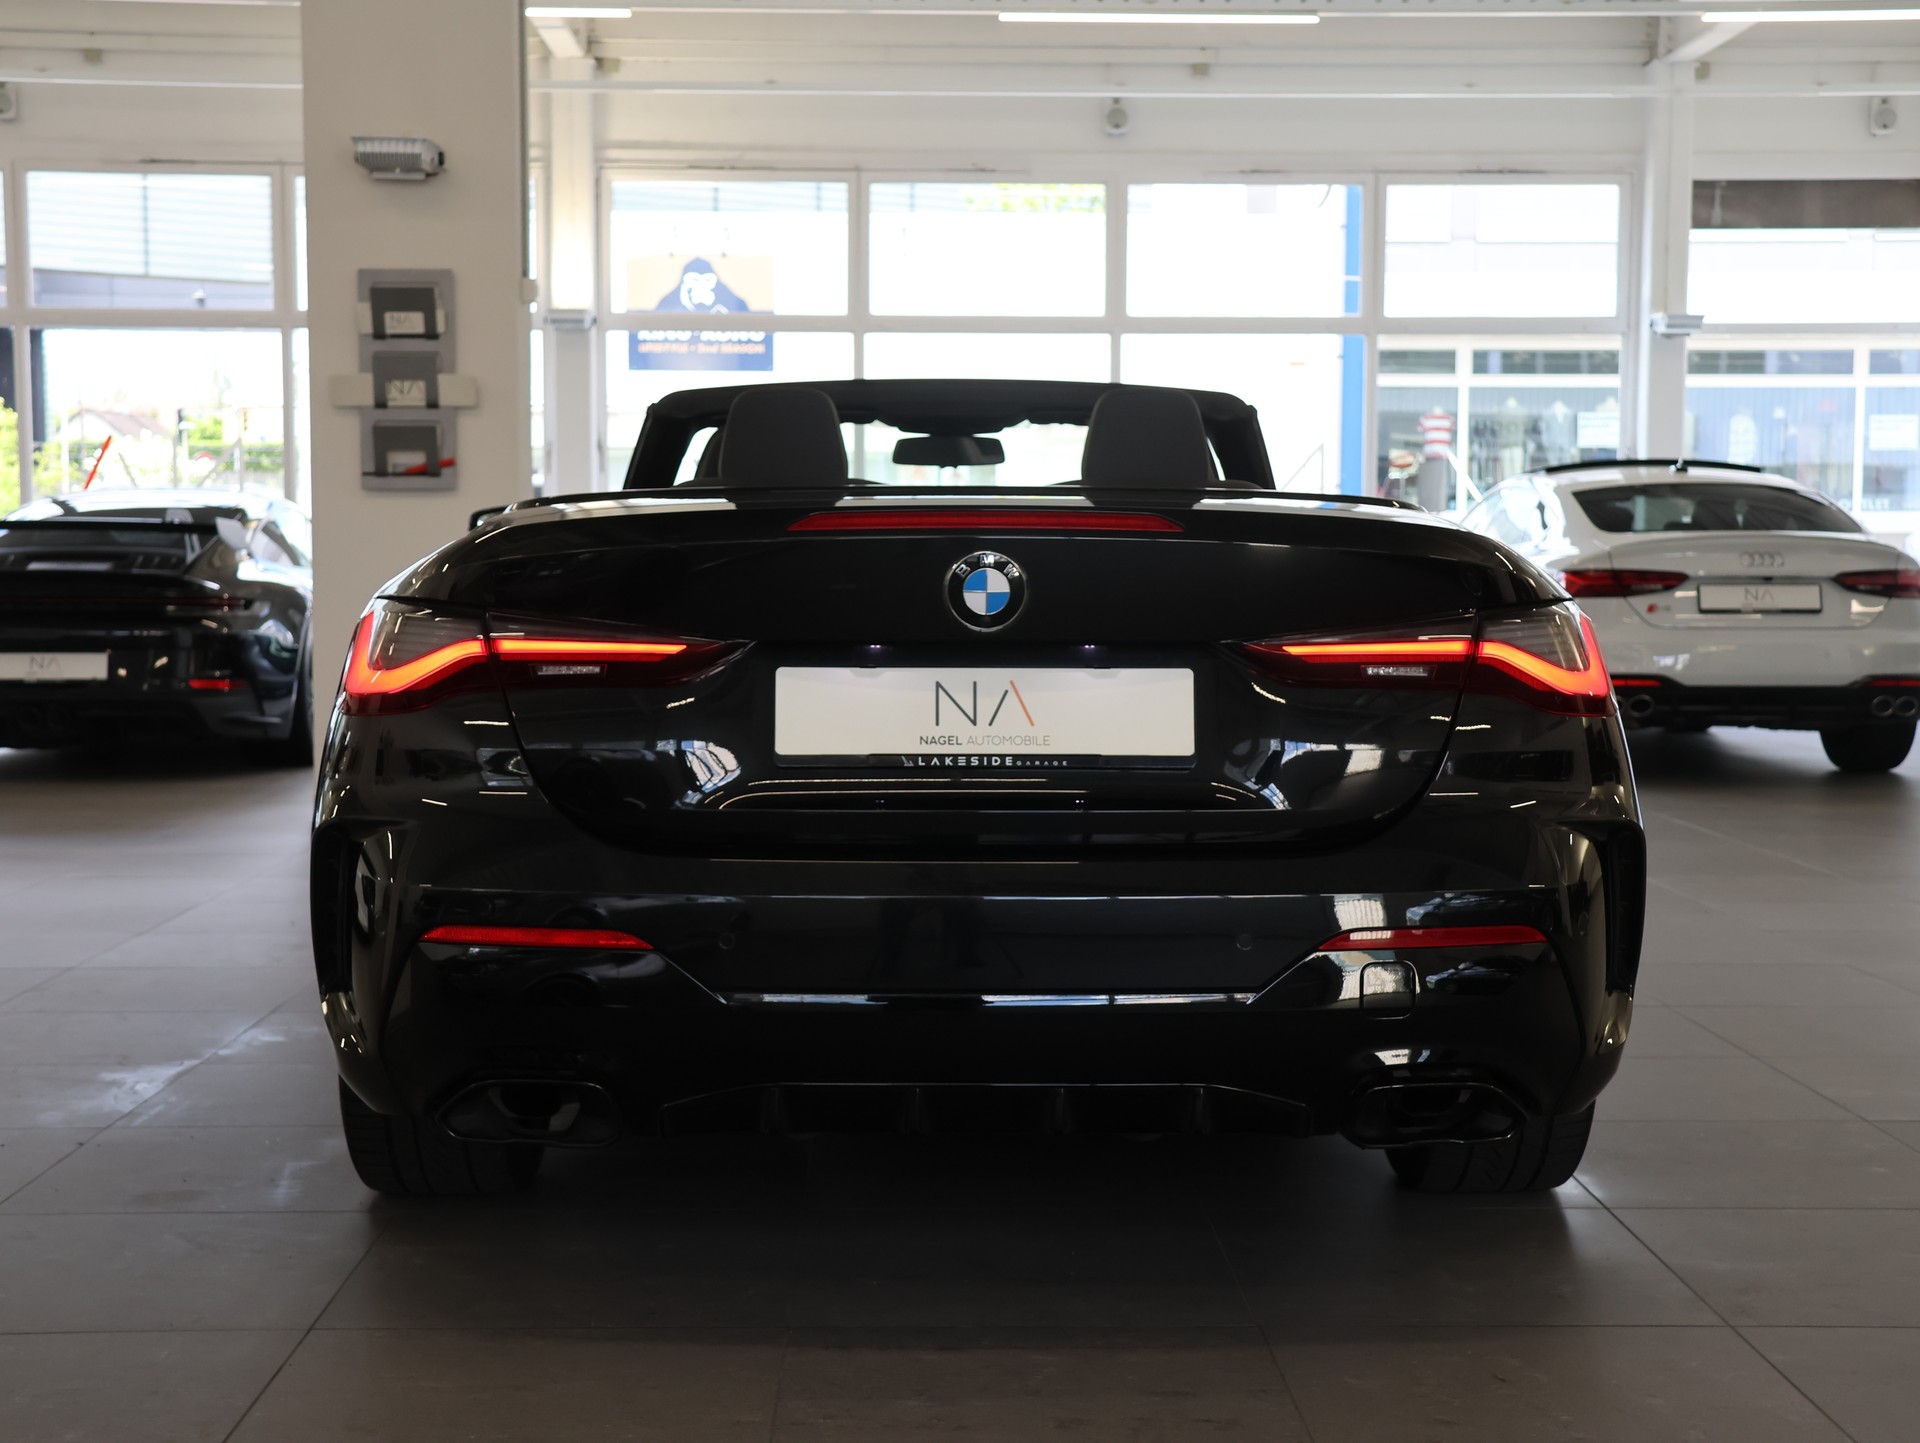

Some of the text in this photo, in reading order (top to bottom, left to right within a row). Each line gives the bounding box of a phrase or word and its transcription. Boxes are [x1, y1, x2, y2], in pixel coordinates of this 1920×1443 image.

[955, 554, 1020, 580] BMW
[935, 679, 1035, 727] NA
[919, 735, 1051, 746] NAGEL AUTOMOBILE
[917, 756, 1014, 766] LAKESIDE
